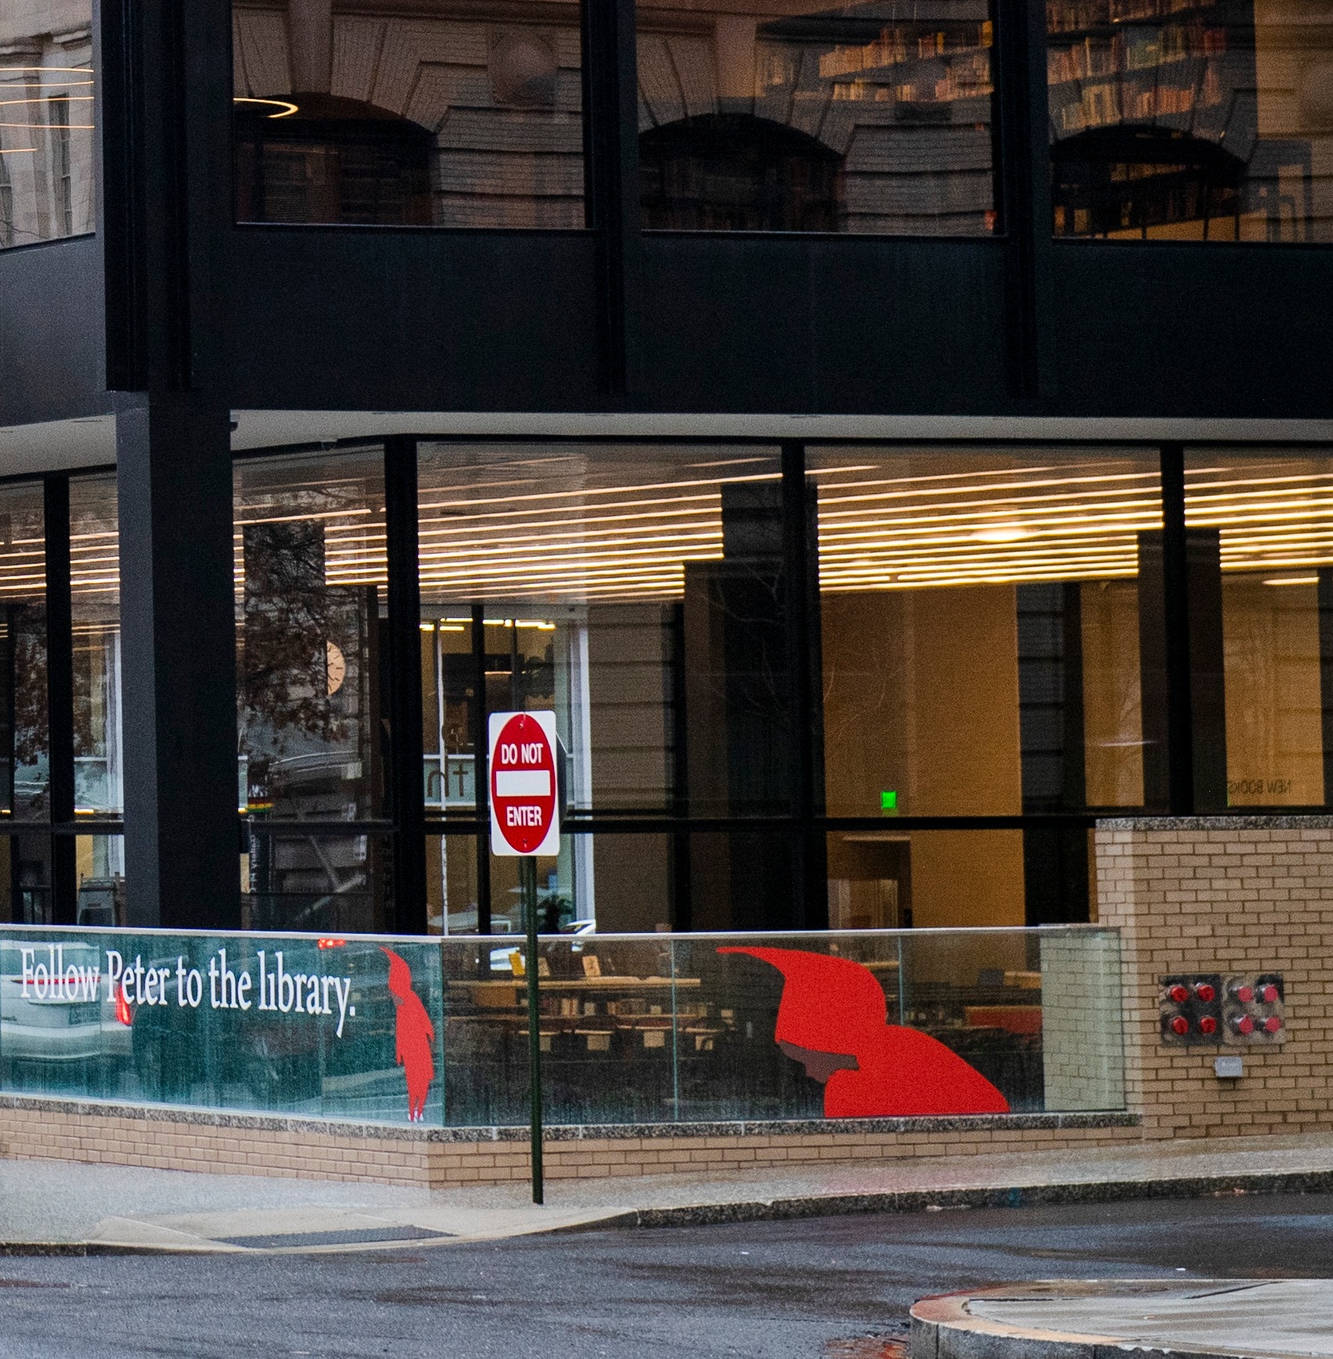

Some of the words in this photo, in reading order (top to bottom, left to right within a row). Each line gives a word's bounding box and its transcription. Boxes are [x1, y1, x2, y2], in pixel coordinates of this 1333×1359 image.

[501, 743, 518, 765] DO
[521, 743, 543, 764] NOT
[506, 806, 542, 827] ENTER
[20, 944, 100, 1002] Follow
[106, 950, 171, 1007] Peter
[175, 955, 203, 1008] to
[208, 948, 252, 1010] the
[256, 949, 356, 1039] library.
